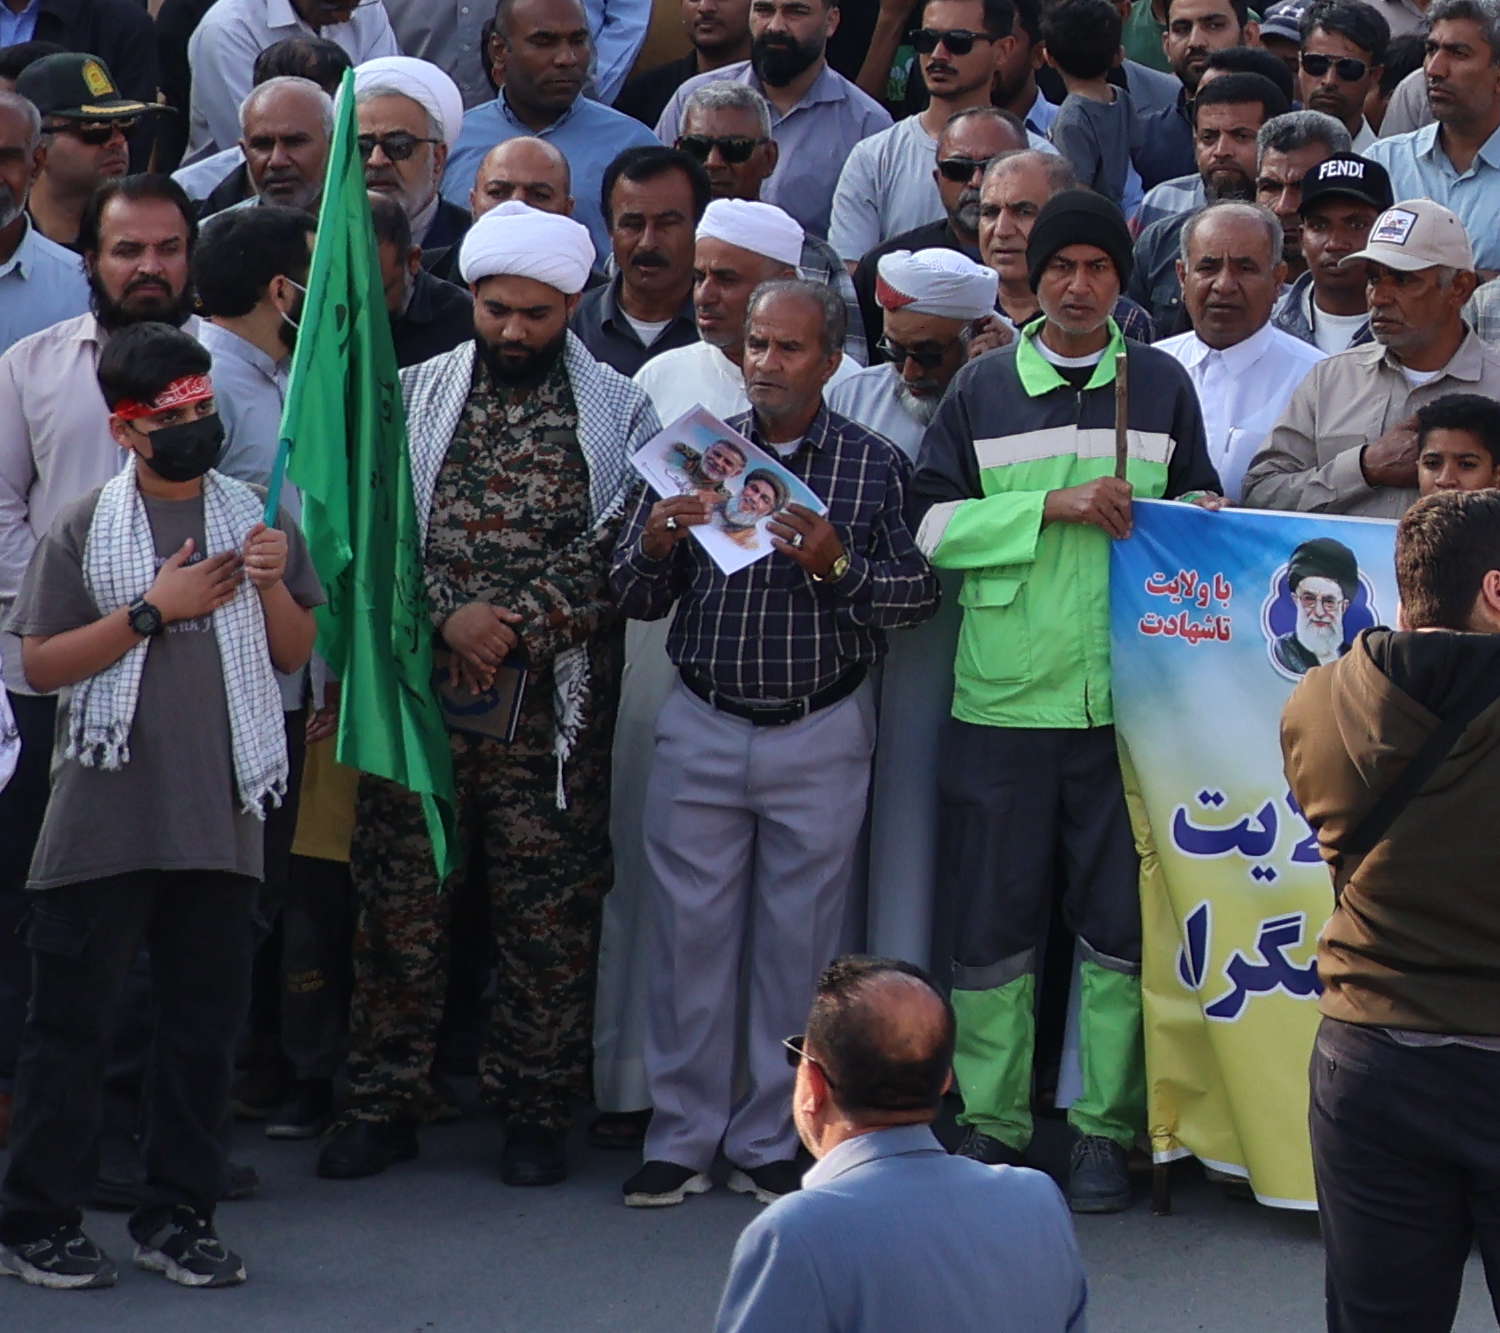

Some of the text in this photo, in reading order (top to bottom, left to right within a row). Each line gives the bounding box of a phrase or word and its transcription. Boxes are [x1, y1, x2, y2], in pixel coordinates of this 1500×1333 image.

[1318, 160, 1365, 180] FENDI
[1144, 569, 1232, 609] با ولایت
